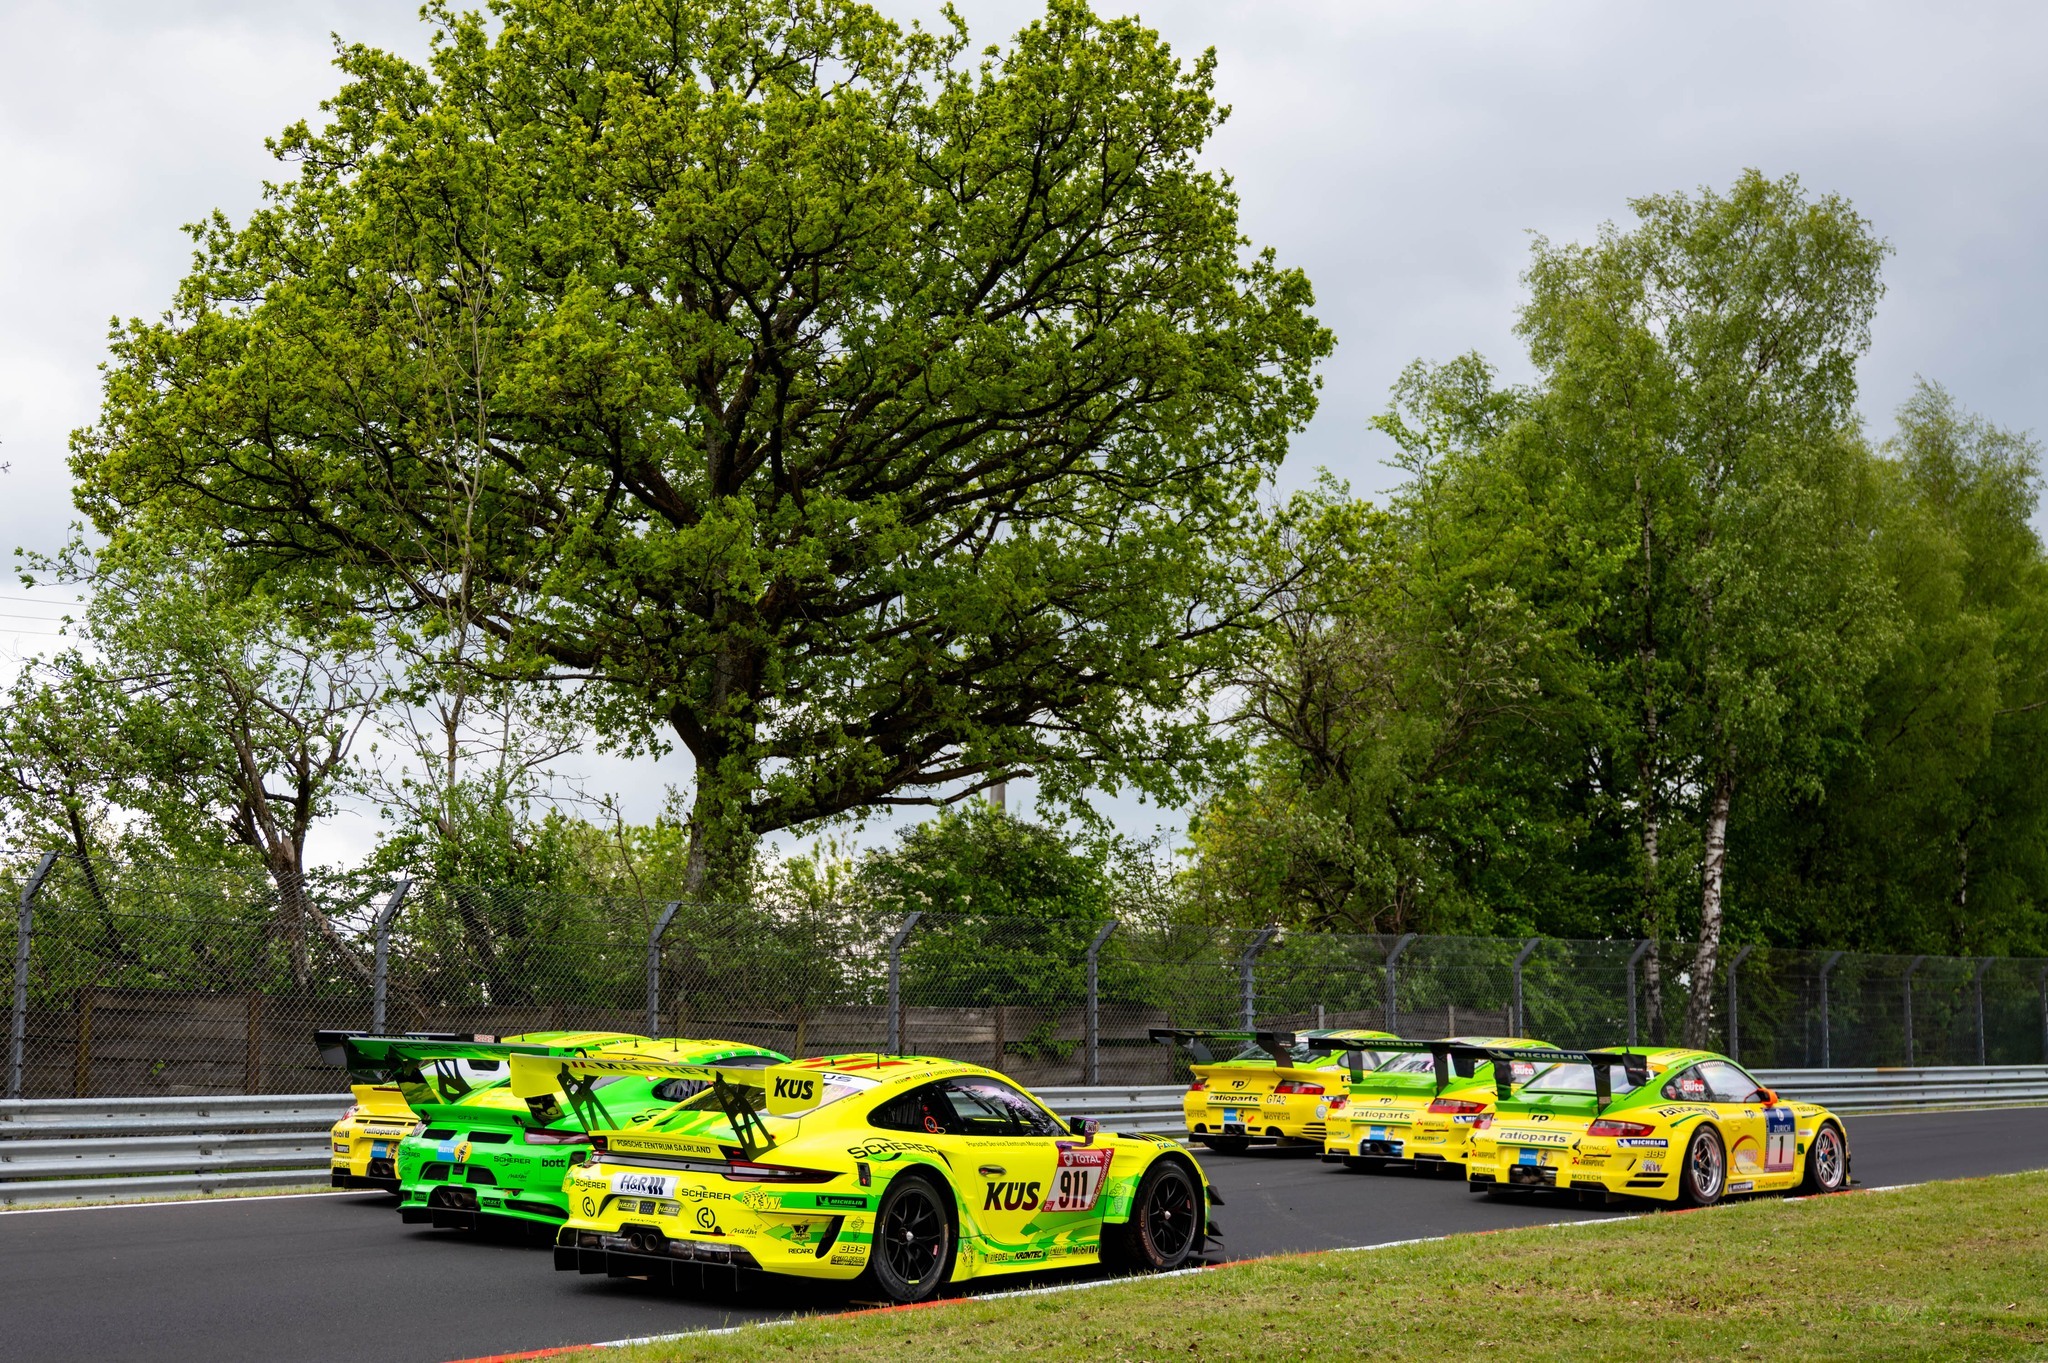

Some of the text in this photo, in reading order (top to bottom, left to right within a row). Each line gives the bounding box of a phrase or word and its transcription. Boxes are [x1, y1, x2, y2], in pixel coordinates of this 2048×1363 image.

[1513, 1052, 1584, 1060] MICHELIN
[595, 1062, 711, 1076] MANTHEY
[774, 1076, 815, 1100] KÜS
[1231, 1080, 1245, 1088] rp
[1209, 1094, 1258, 1103] ratioparts
[1266, 1094, 1287, 1105] GTA2
[1353, 1110, 1411, 1119] ratioparts
[363, 1128, 402, 1136] ratioparts
[1773, 1124, 1792, 1132] ZURICH
[1500, 1132, 1566, 1142] ratioparts
[616, 1139, 711, 1154] PORSCHE ZENTRUM SAARLAND
[847, 1141, 939, 1160] SCHERER
[1778, 1135, 1784, 1164] 1
[1075, 1154, 1102, 1164] TOTAL
[1644, 1150, 1666, 1158] BBS
[494, 1156, 531, 1165] SCHERER
[541, 1158, 566, 1168] bott
[1645, 1163, 1662, 1171] KW
[575, 1178, 607, 1190] SCHERER
[620, 1174, 647, 1192] H&R
[681, 1188, 731, 1201] SCHERER
[1058, 1170, 1089, 1209] 911
[983, 1181, 1041, 1211] KÜS
[618, 1201, 637, 1209] HAZET
[749, 1194, 782, 1210] KW
[659, 1204, 680, 1213] HAZET
[839, 1244, 866, 1254] BBS
